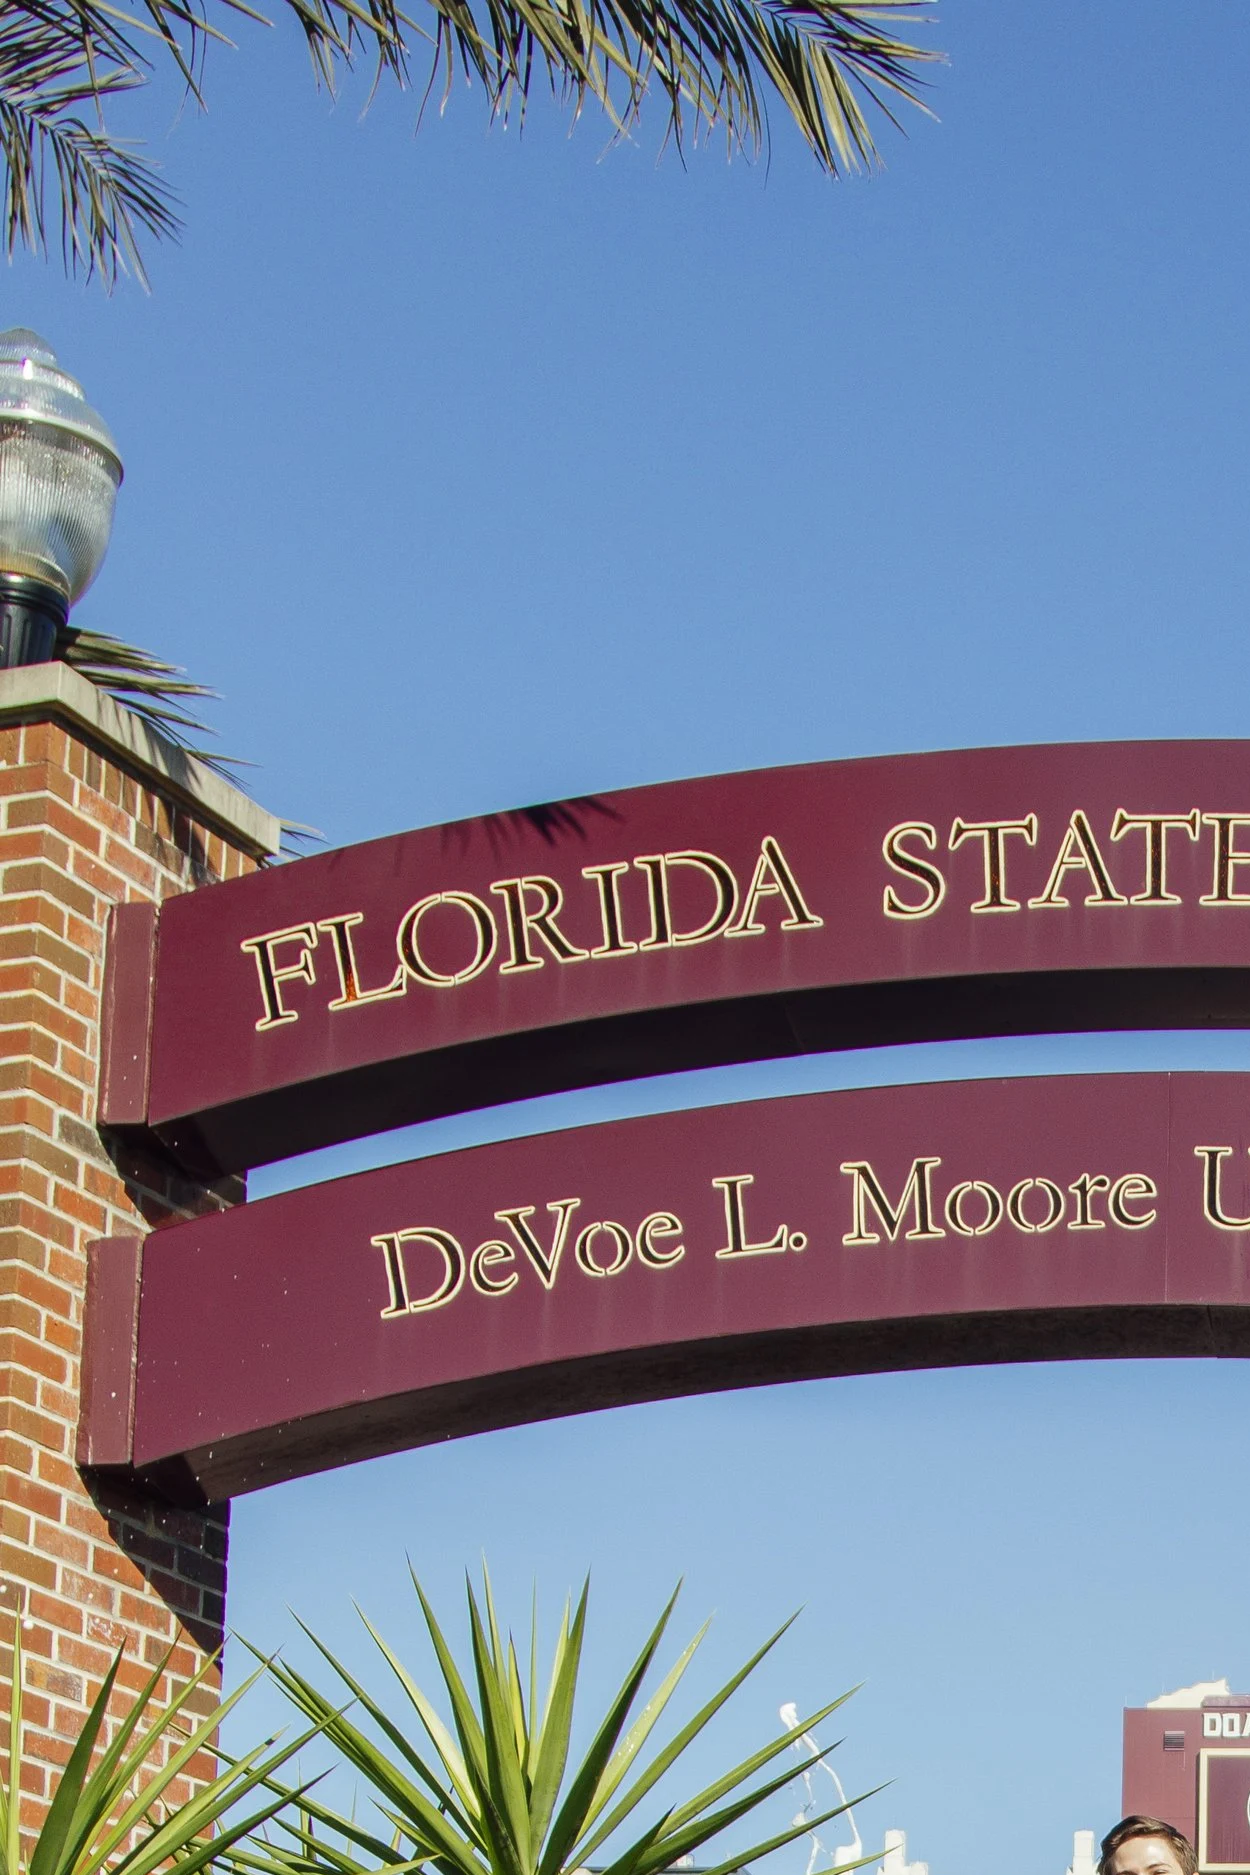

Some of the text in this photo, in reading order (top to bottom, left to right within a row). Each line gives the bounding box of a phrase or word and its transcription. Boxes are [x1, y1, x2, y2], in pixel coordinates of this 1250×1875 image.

[242, 836, 823, 1032] FLORIDA
[371, 1198, 686, 1320] DeVoe
[712, 1174, 808, 1260] L.
[840, 1156, 1159, 1247] Moore
